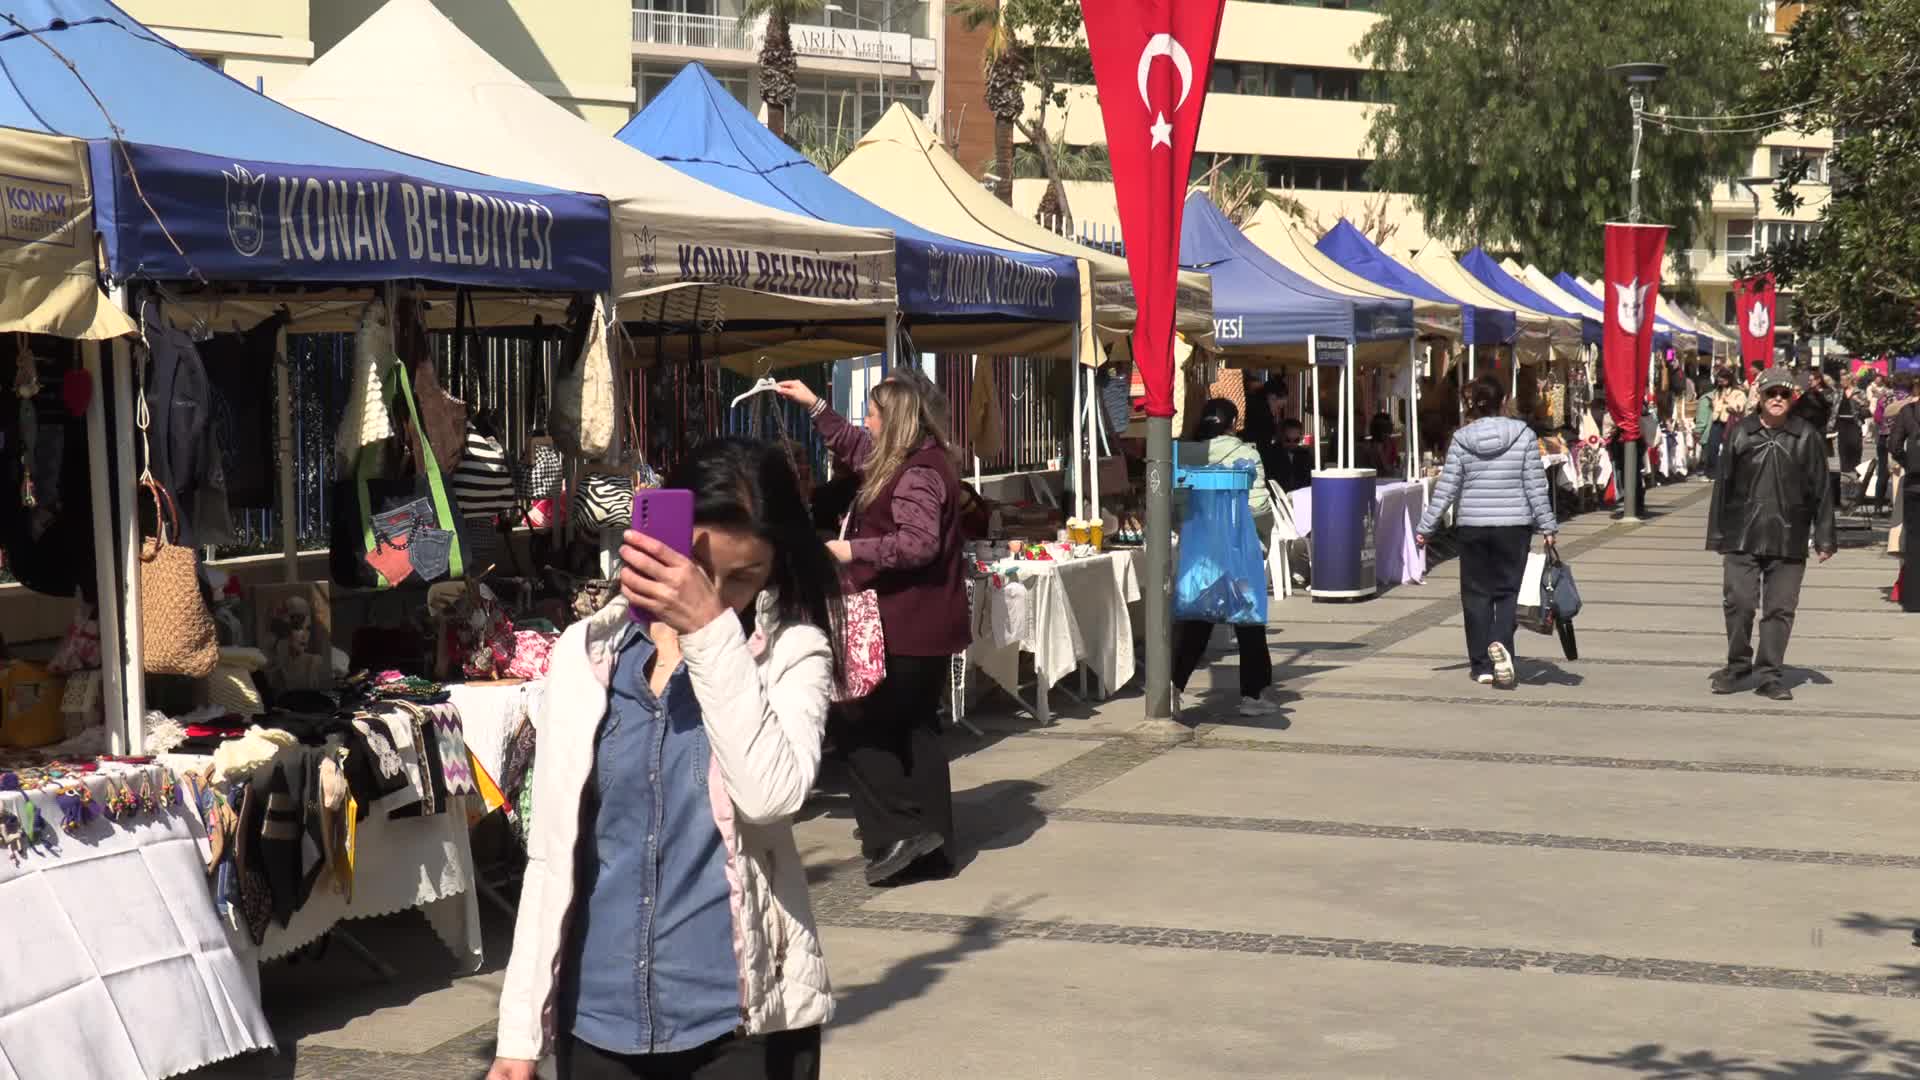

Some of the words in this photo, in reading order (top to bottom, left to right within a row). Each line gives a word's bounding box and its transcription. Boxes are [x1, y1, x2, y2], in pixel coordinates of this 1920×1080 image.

[6, 186, 66, 216] KONAK
[278, 176, 397, 261] KONAK
[678, 244, 749, 288] KONAK
[753, 249, 858, 300] BELEDİYESİ
[946, 252, 991, 304] KONAK
[1212, 315, 1243, 338] YESİ
